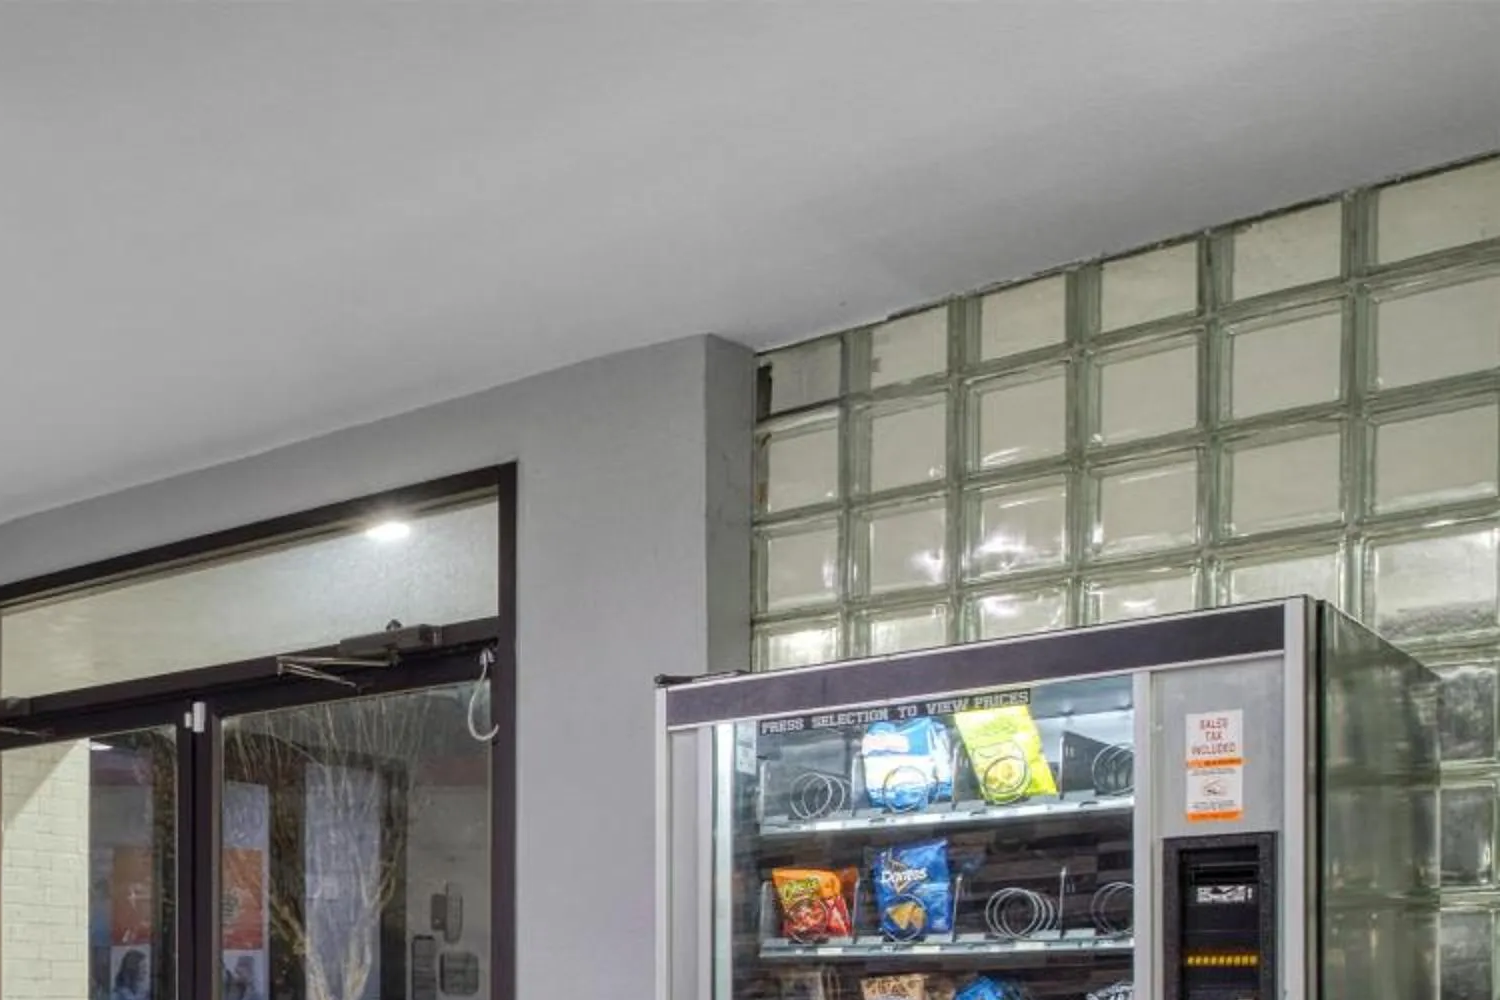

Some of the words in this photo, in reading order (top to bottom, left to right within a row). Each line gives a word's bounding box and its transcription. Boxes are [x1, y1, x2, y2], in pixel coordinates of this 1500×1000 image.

[761, 717, 804, 735] PRESS
[811, 707, 888, 728] SELECTION
[897, 704, 917, 719] TO
[925, 697, 969, 714] VIEW
[974, 690, 1029, 708] PRICES
